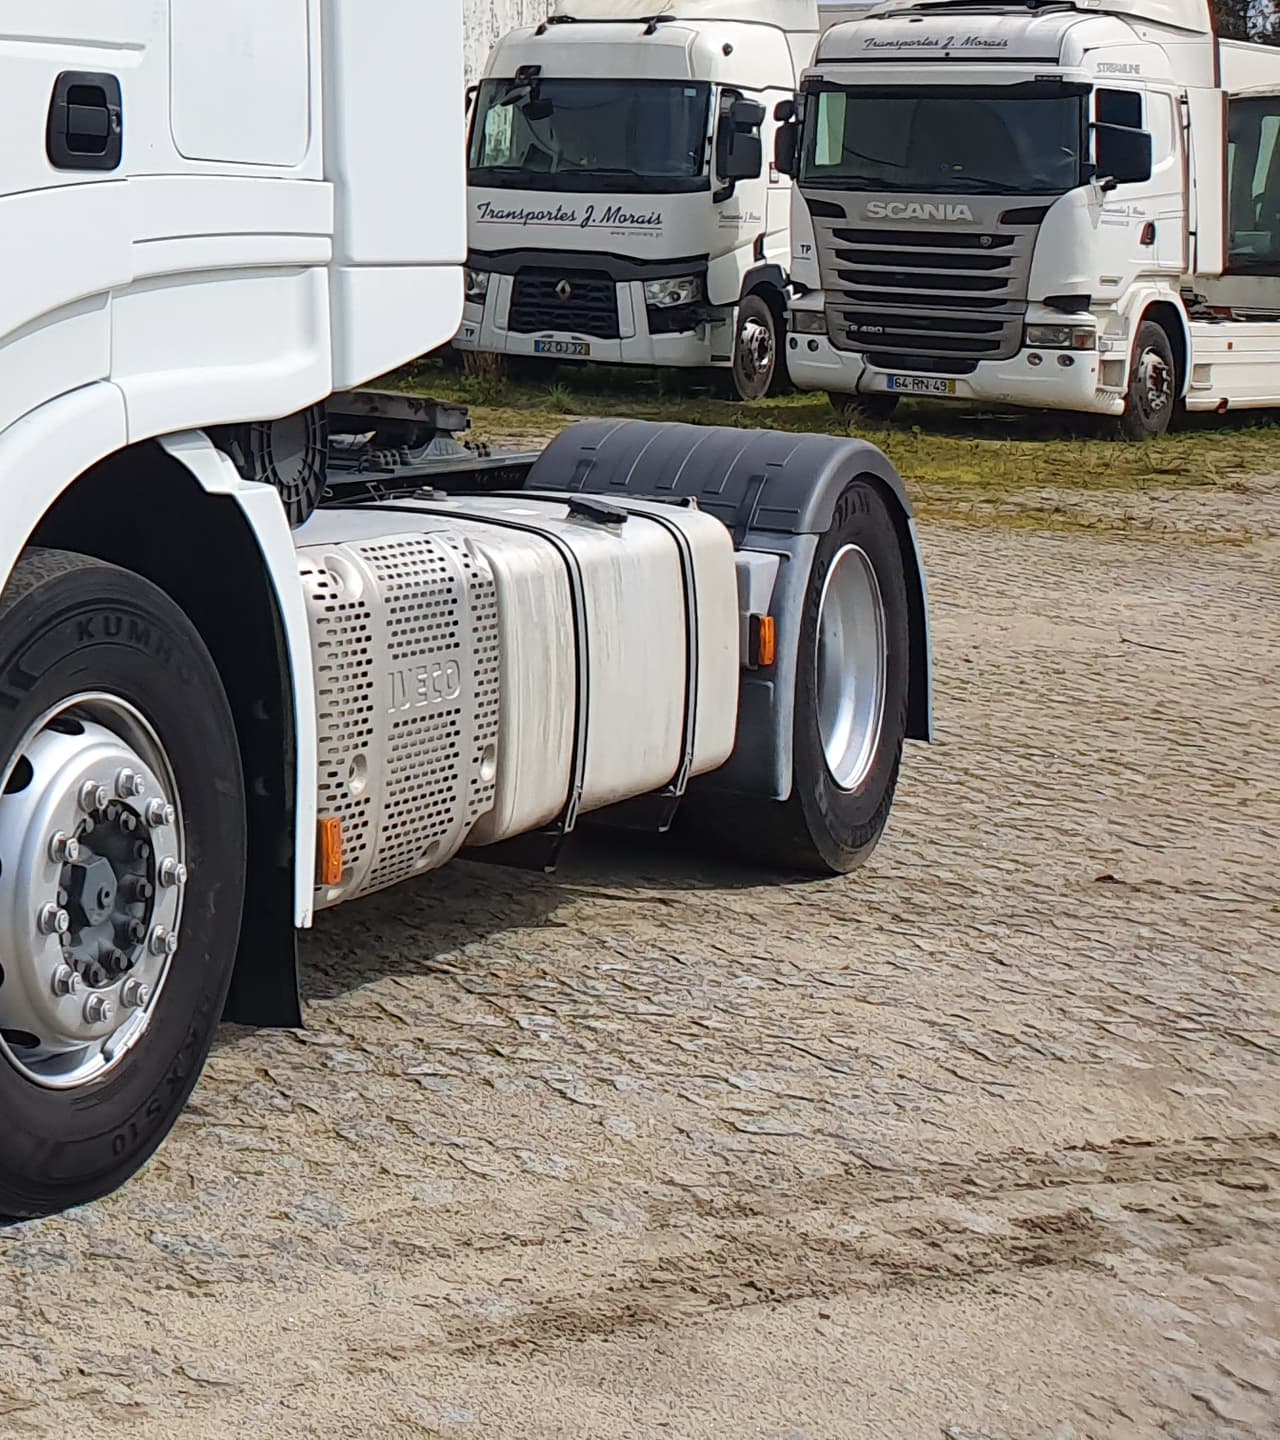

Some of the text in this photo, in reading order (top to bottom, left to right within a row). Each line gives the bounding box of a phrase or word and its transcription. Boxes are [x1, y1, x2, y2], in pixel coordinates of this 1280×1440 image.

[863, 36, 939, 50] Transportes
[960, 35, 1009, 48] Morais
[476, 201, 663, 229] Transportes J. Morais
[865, 200, 974, 222] SCANIA
[800, 244, 812, 255] TP
[387, 659, 461, 714] IVECO
